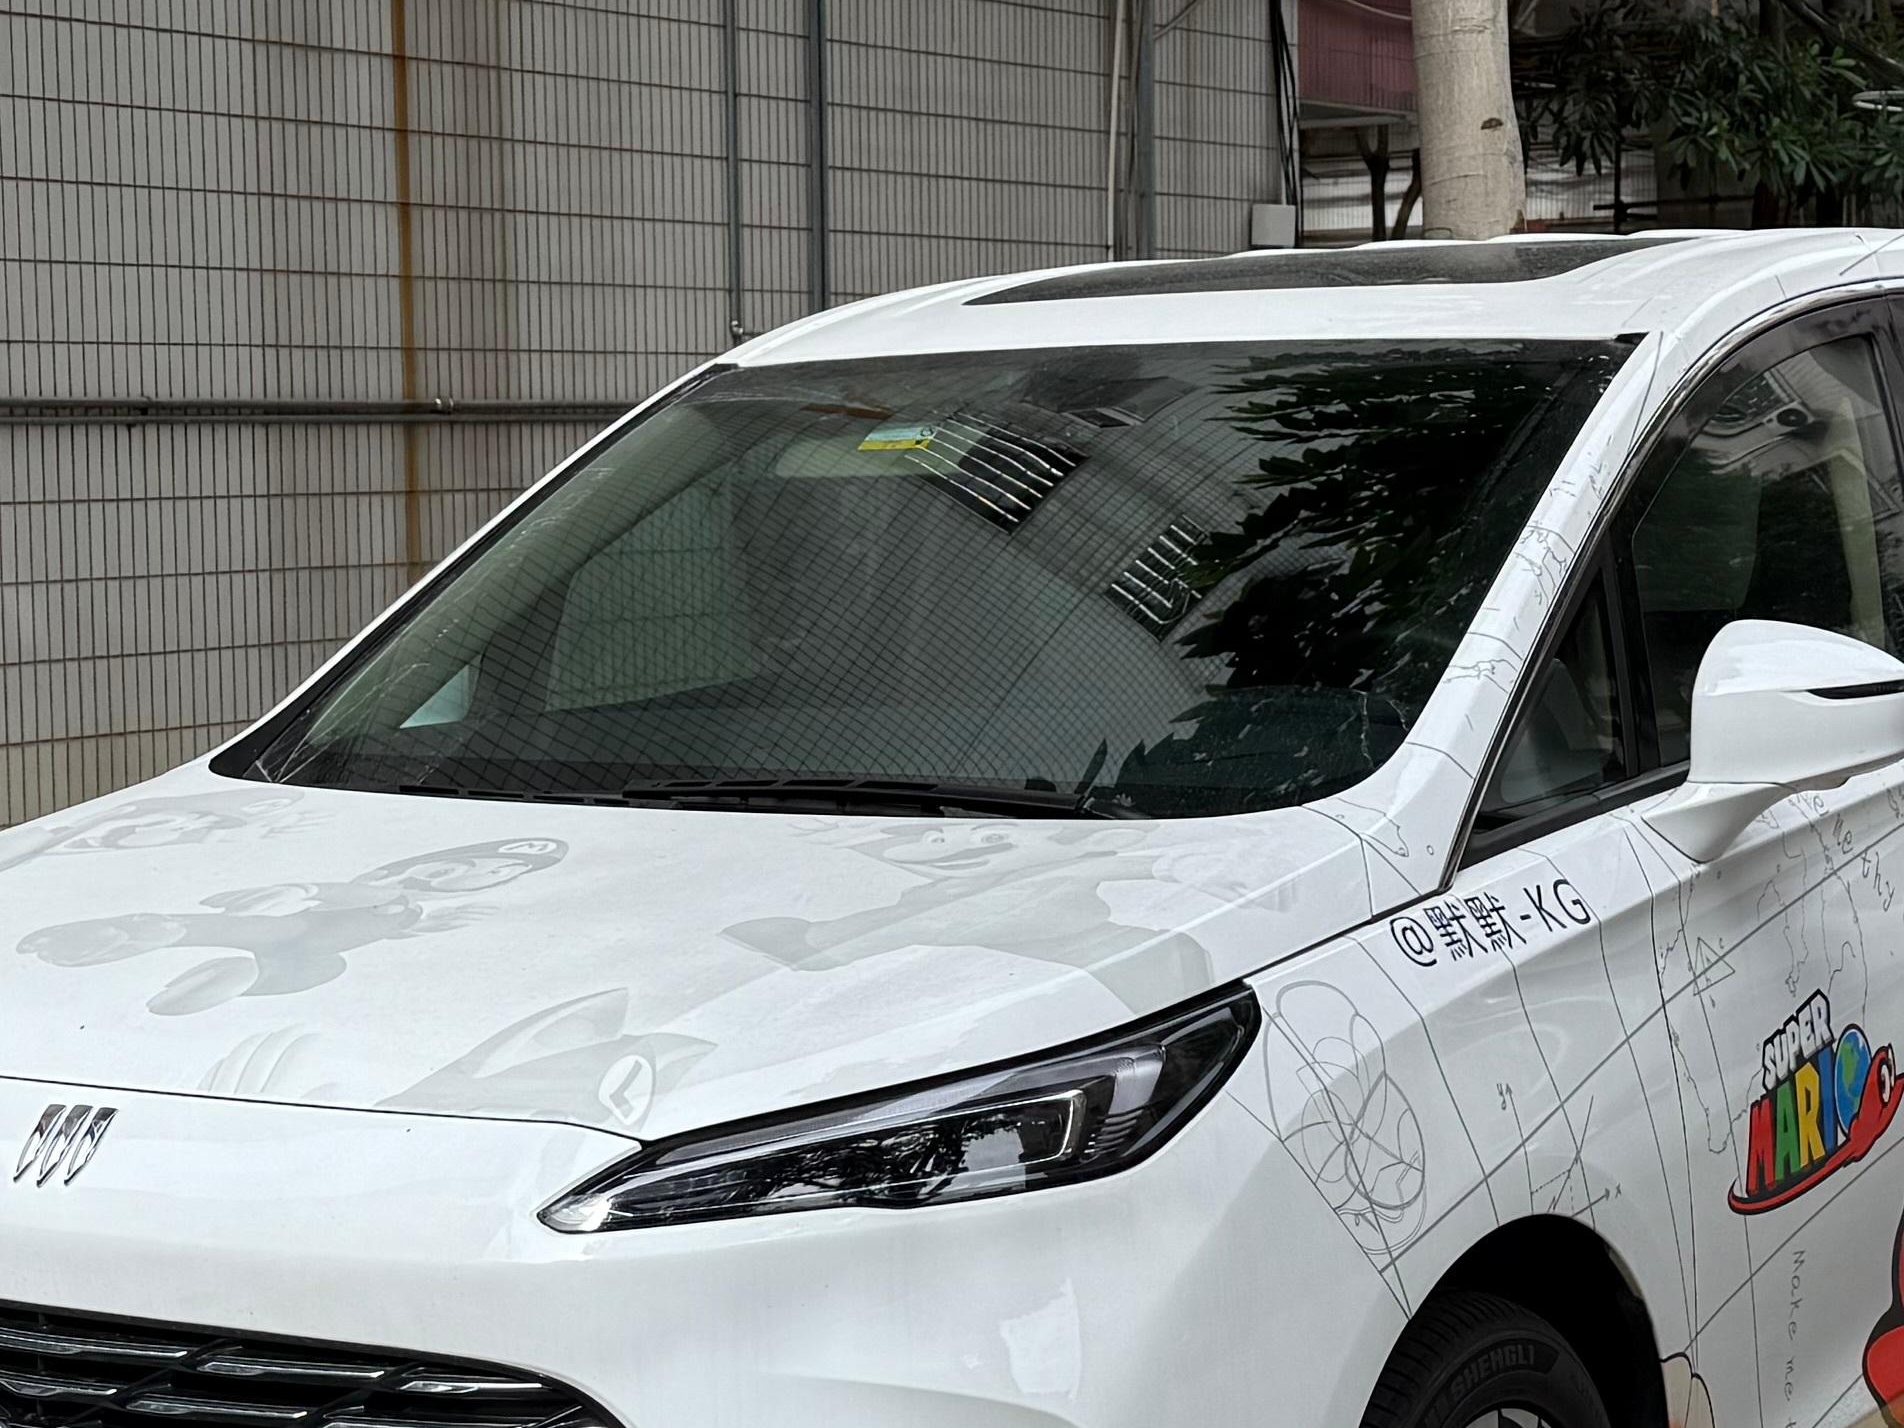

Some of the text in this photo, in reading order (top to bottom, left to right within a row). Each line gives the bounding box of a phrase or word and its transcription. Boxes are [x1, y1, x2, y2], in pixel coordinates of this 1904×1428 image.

[1389, 878, 1592, 967] @默默-KG
[1761, 988, 1836, 1095] SUPER
[1746, 1023, 1873, 1199] MARIO
[1786, 1250, 1807, 1342] Make
